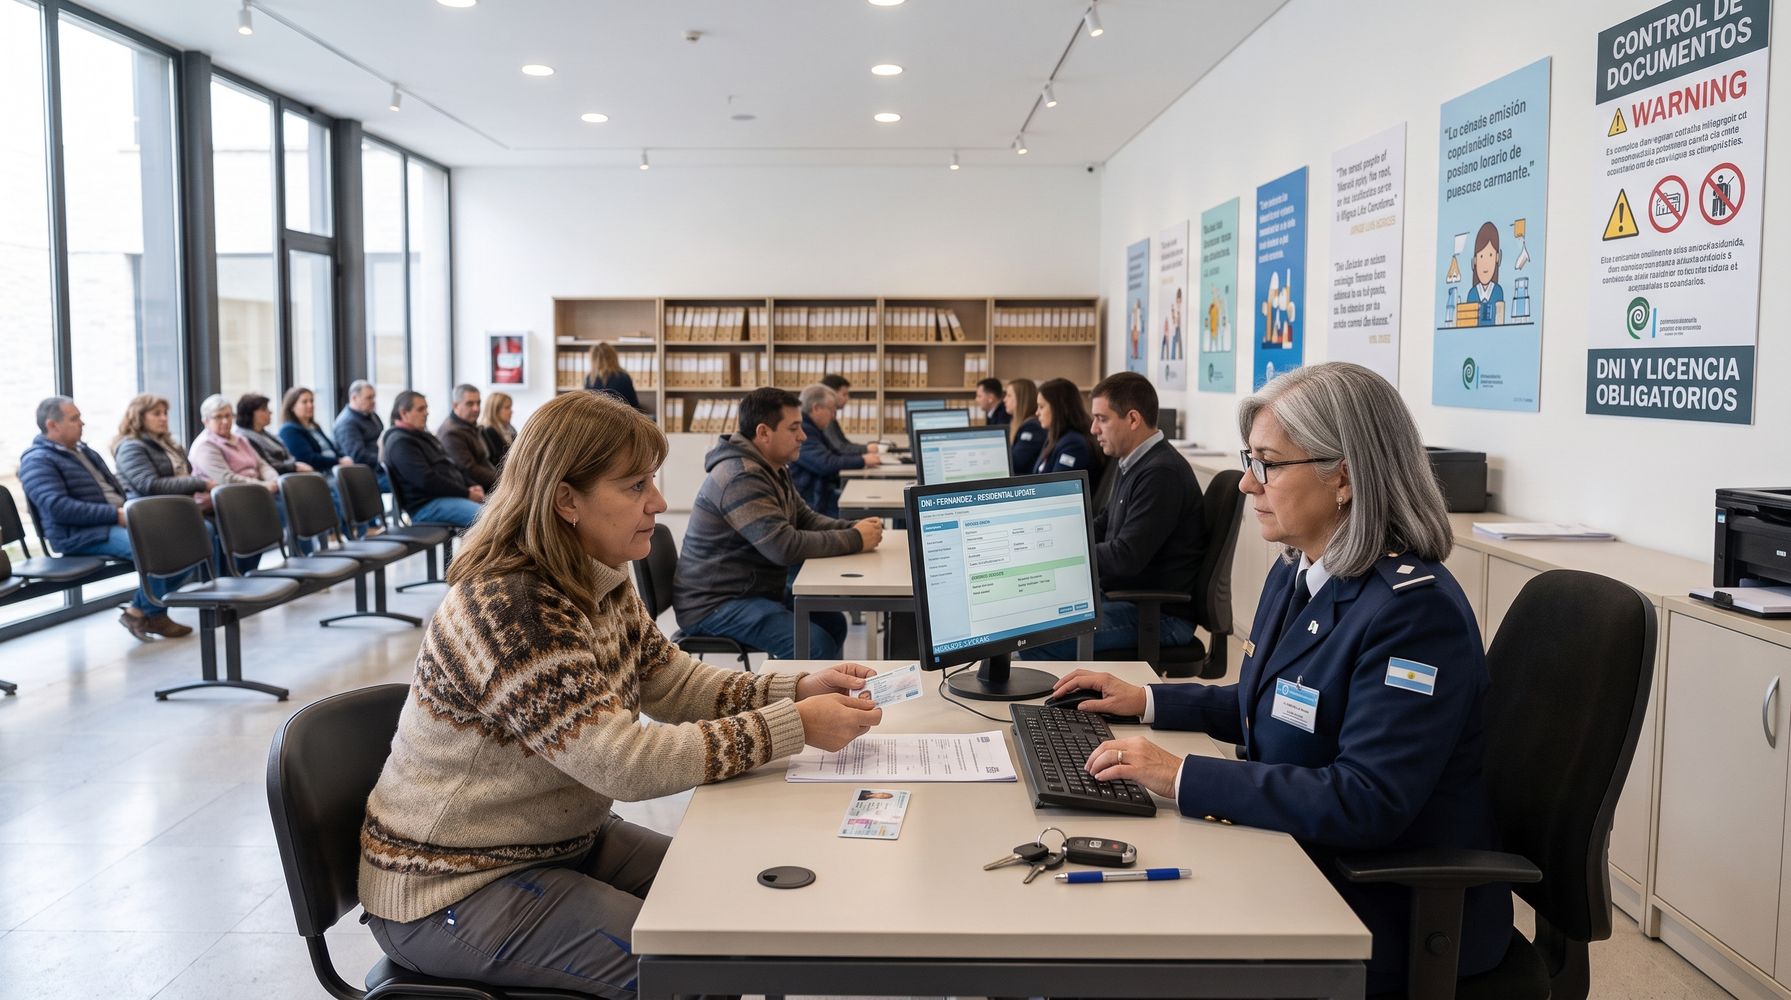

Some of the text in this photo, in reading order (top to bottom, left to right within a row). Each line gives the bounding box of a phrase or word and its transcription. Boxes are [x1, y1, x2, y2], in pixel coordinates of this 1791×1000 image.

[1613, 0, 1743, 60] CONTROL DE
[1607, 16, 1752, 91] DOCUMENTOS
[1489, 99, 1526, 125] emisión
[1631, 69, 1748, 128] WARNING
[1510, 144, 1522, 160] de
[1596, 357, 1740, 381] DNI Y LICENCIA
[1596, 384, 1738, 412] OBLIGATORIOS
[921, 499, 932, 508] DNI
[936, 495, 973, 507] FERNANDEZ
[977, 490, 1014, 502] RESIDENTIAL
[1015, 487, 1036, 497] UPDATE
